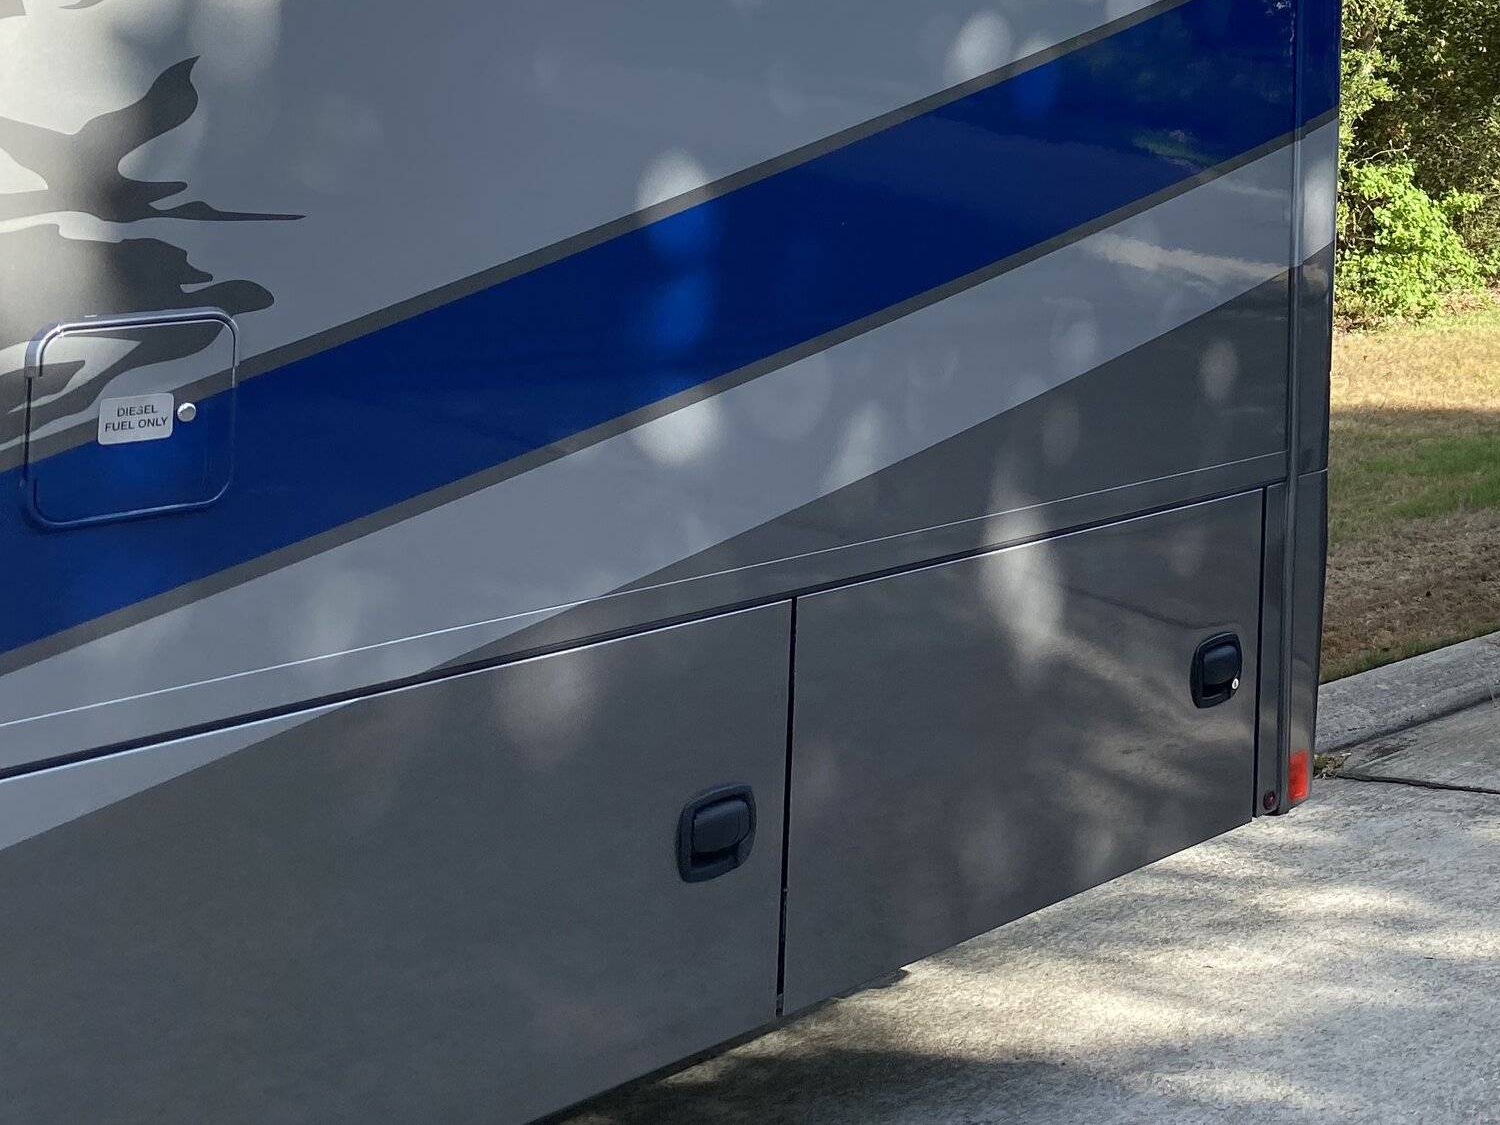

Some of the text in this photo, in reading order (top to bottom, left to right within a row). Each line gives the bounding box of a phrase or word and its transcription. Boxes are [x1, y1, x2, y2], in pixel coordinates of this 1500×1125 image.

[117, 404, 158, 417] DIESEL
[104, 416, 168, 432] FUEL ONLY
